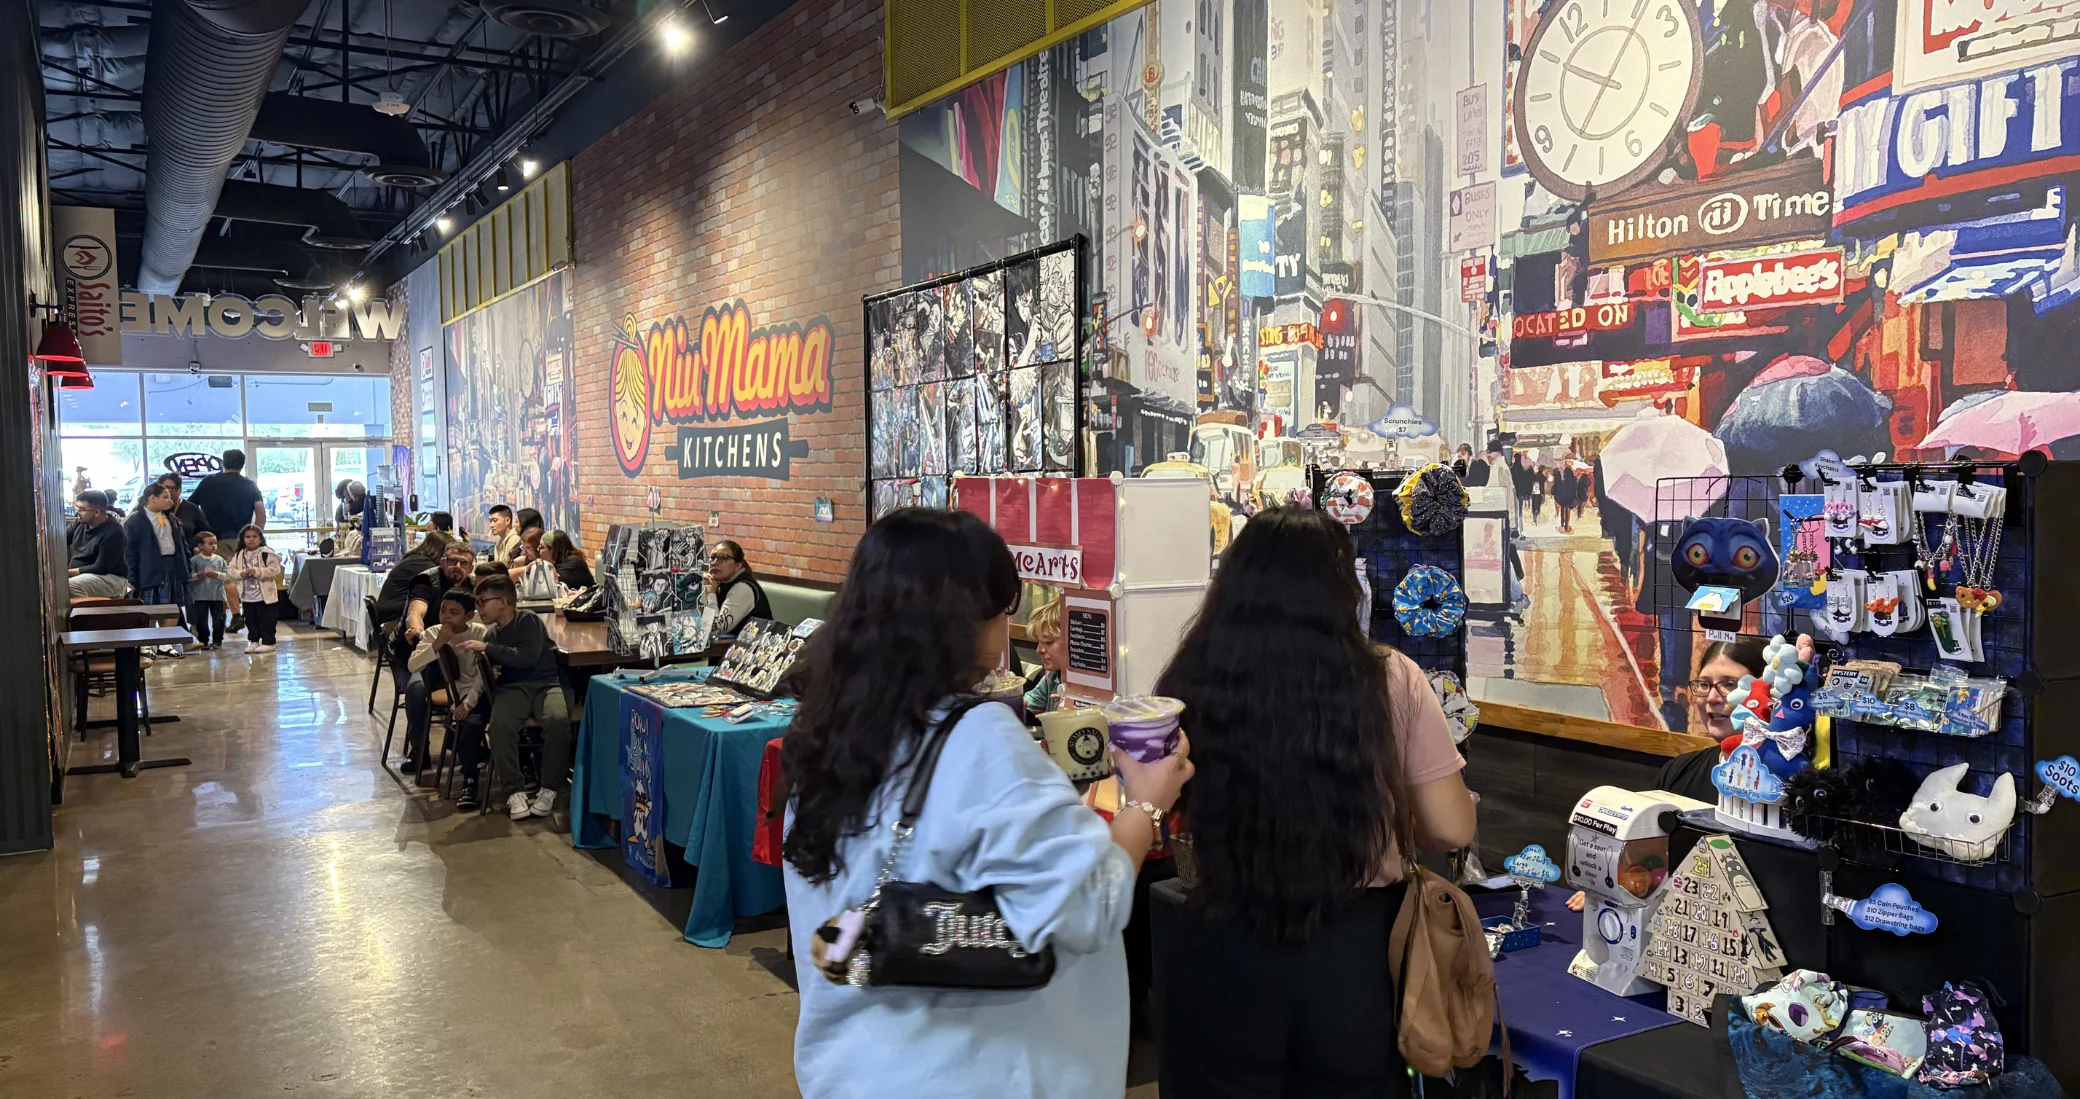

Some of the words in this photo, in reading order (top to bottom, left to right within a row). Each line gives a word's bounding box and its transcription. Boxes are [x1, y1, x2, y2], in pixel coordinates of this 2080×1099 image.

[1559, 2, 1588, 43] 12
[1656, 5, 1679, 37] 3
[1463, 93, 1480, 107] BUS
[1534, 125, 1553, 153] 9
[1625, 130, 1642, 157] 6
[1464, 189, 1490, 204] BUSES
[1465, 208, 1489, 221] ONLY
[1608, 214, 1688, 245] Hilton
[1753, 191, 1829, 221] Time
[1276, 253, 1301, 278] TY
[77, 281, 113, 337] Saito's
[1597, 304, 1629, 327] ON
[650, 320, 703, 418] Niu
[702, 307, 831, 414] Mama
[1384, 417, 1422, 426] Scrunchies
[683, 431, 782, 468] KITCHENS
[1782, 594, 1794, 604] $20
[1708, 630, 1722, 640] Pull
[1724, 632, 1734, 641] Me
[1832, 669, 1858, 678] MYSTERY
[1817, 692, 1828, 700] $8
[1862, 697, 1876, 705] $10
[1904, 702, 1915, 711] $8
[2058, 760, 2076, 777] $10
[2045, 764, 2080, 795] Soots
[1722, 782, 1748, 796] Handmade
[1748, 788, 1760, 799] Pals
[1574, 814, 1593, 826] $10.00
[1592, 820, 1603, 829] Per
[1603, 823, 1617, 835] Play
[1580, 838, 1589, 848] Get
[1580, 860, 1597, 870] unlock
[1586, 852, 1597, 860] and
[1584, 870, 1598, 879] door
[1684, 877, 1699, 895] 23
[1702, 883, 1719, 901] 22
[1675, 899, 1688, 915] 21
[1692, 902, 1708, 921] 20
[1877, 900, 1892, 908] Coin
[1892, 903, 1919, 913] Pouches
[1878, 907, 1898, 919] Zipper
[1898, 913, 1914, 922] Bags
[1713, 910, 1729, 929] 19
[1864, 915, 1875, 923] $12
[1875, 917, 1909, 930] Drawstring
[1909, 924, 1925, 933] bags
[1664, 919, 1680, 939] 18
[1682, 925, 1697, 943] 17
[1703, 931, 1719, 951] 16
[1722, 938, 1737, 957] 15
[1673, 945, 1688, 965] 13
[1693, 952, 1708, 973] 12
[1667, 967, 1676, 983] 5
[1711, 959, 1726, 979] 11
[1731, 966, 1747, 985] 10
[1684, 973, 1695, 989] 6
[1703, 980, 1716, 997] 7
[1675, 996, 1685, 1013] 3
[1694, 1004, 1705, 1022] 2
